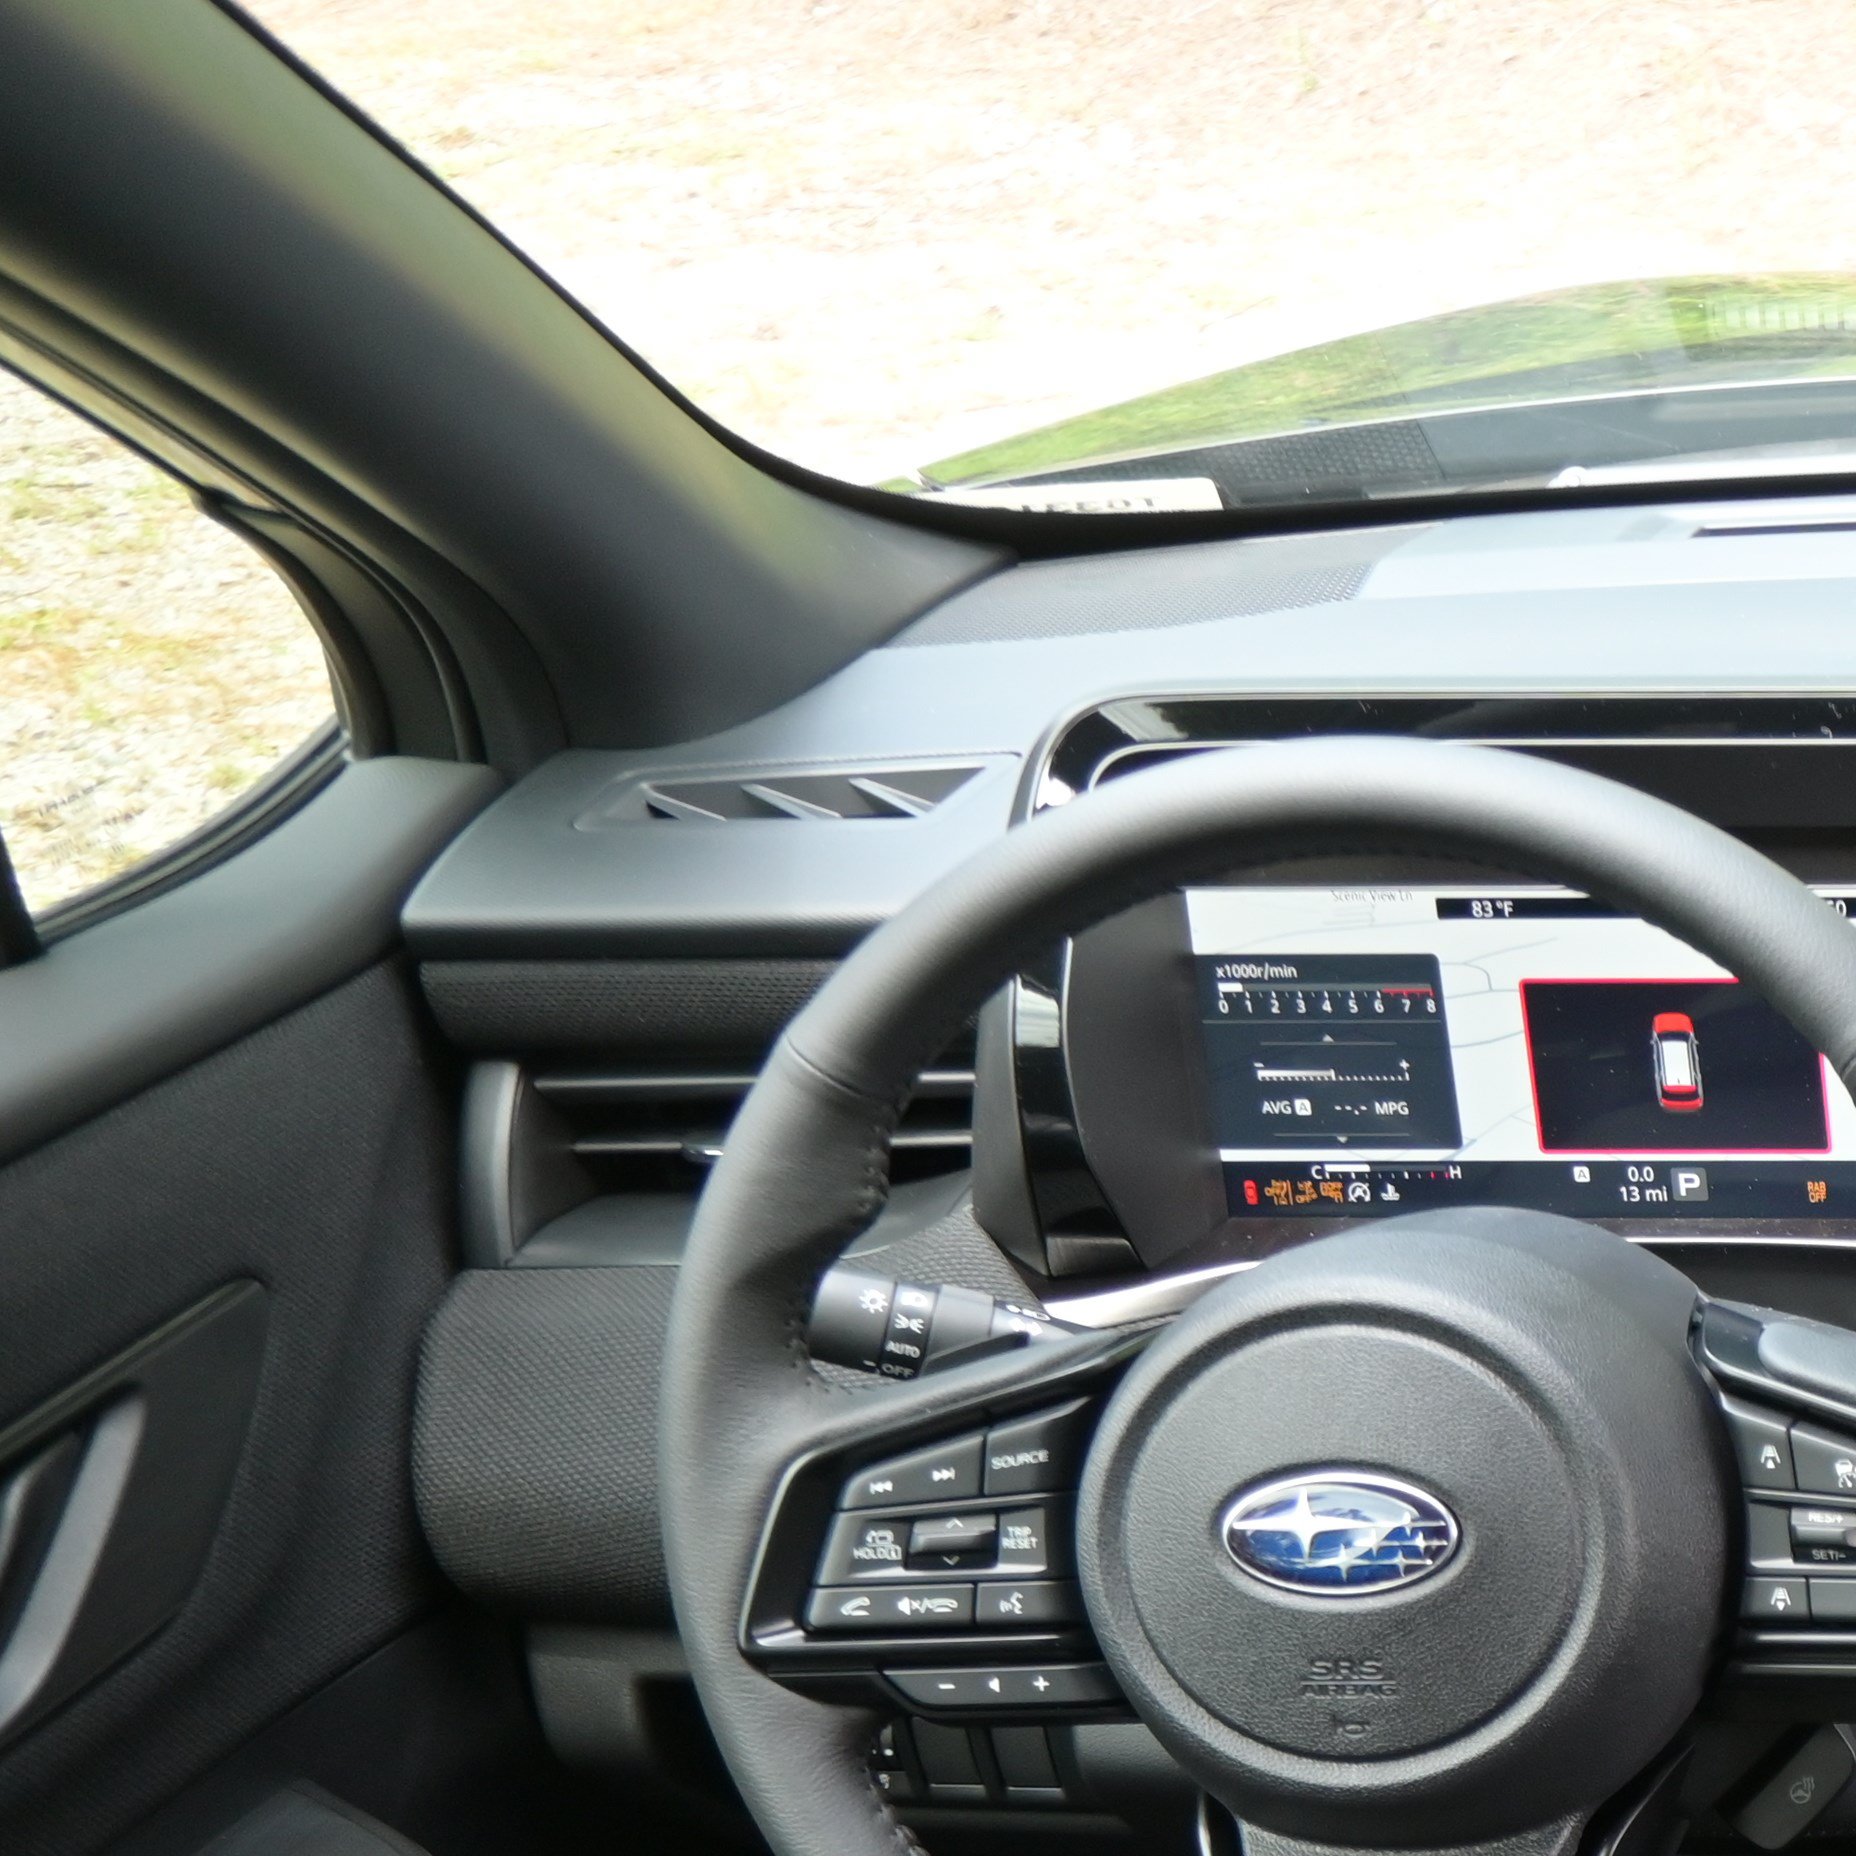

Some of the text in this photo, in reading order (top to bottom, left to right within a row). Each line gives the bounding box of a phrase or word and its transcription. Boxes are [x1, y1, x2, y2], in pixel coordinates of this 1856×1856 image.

[1369, 889, 1397, 903] View
[1471, 899, 1495, 918] 83
[1215, 963, 1298, 981] x1000r/min
[1219, 1000, 1437, 1014] 0 1 2 3 4 5 6 7 8
[1261, 1101, 1292, 1116] AVG
[1375, 1101, 1410, 1116] MPG
[1311, 1164, 1323, 1180] C
[1450, 1165, 1462, 1179] H
[1627, 1165, 1655, 1182] 0.0
[1619, 1185, 1668, 1202] 13 mi
[1677, 1173, 1700, 1197] P
[990, 1449, 1049, 1470] SOURCE
[1308, 1660, 1385, 1681] SRS
